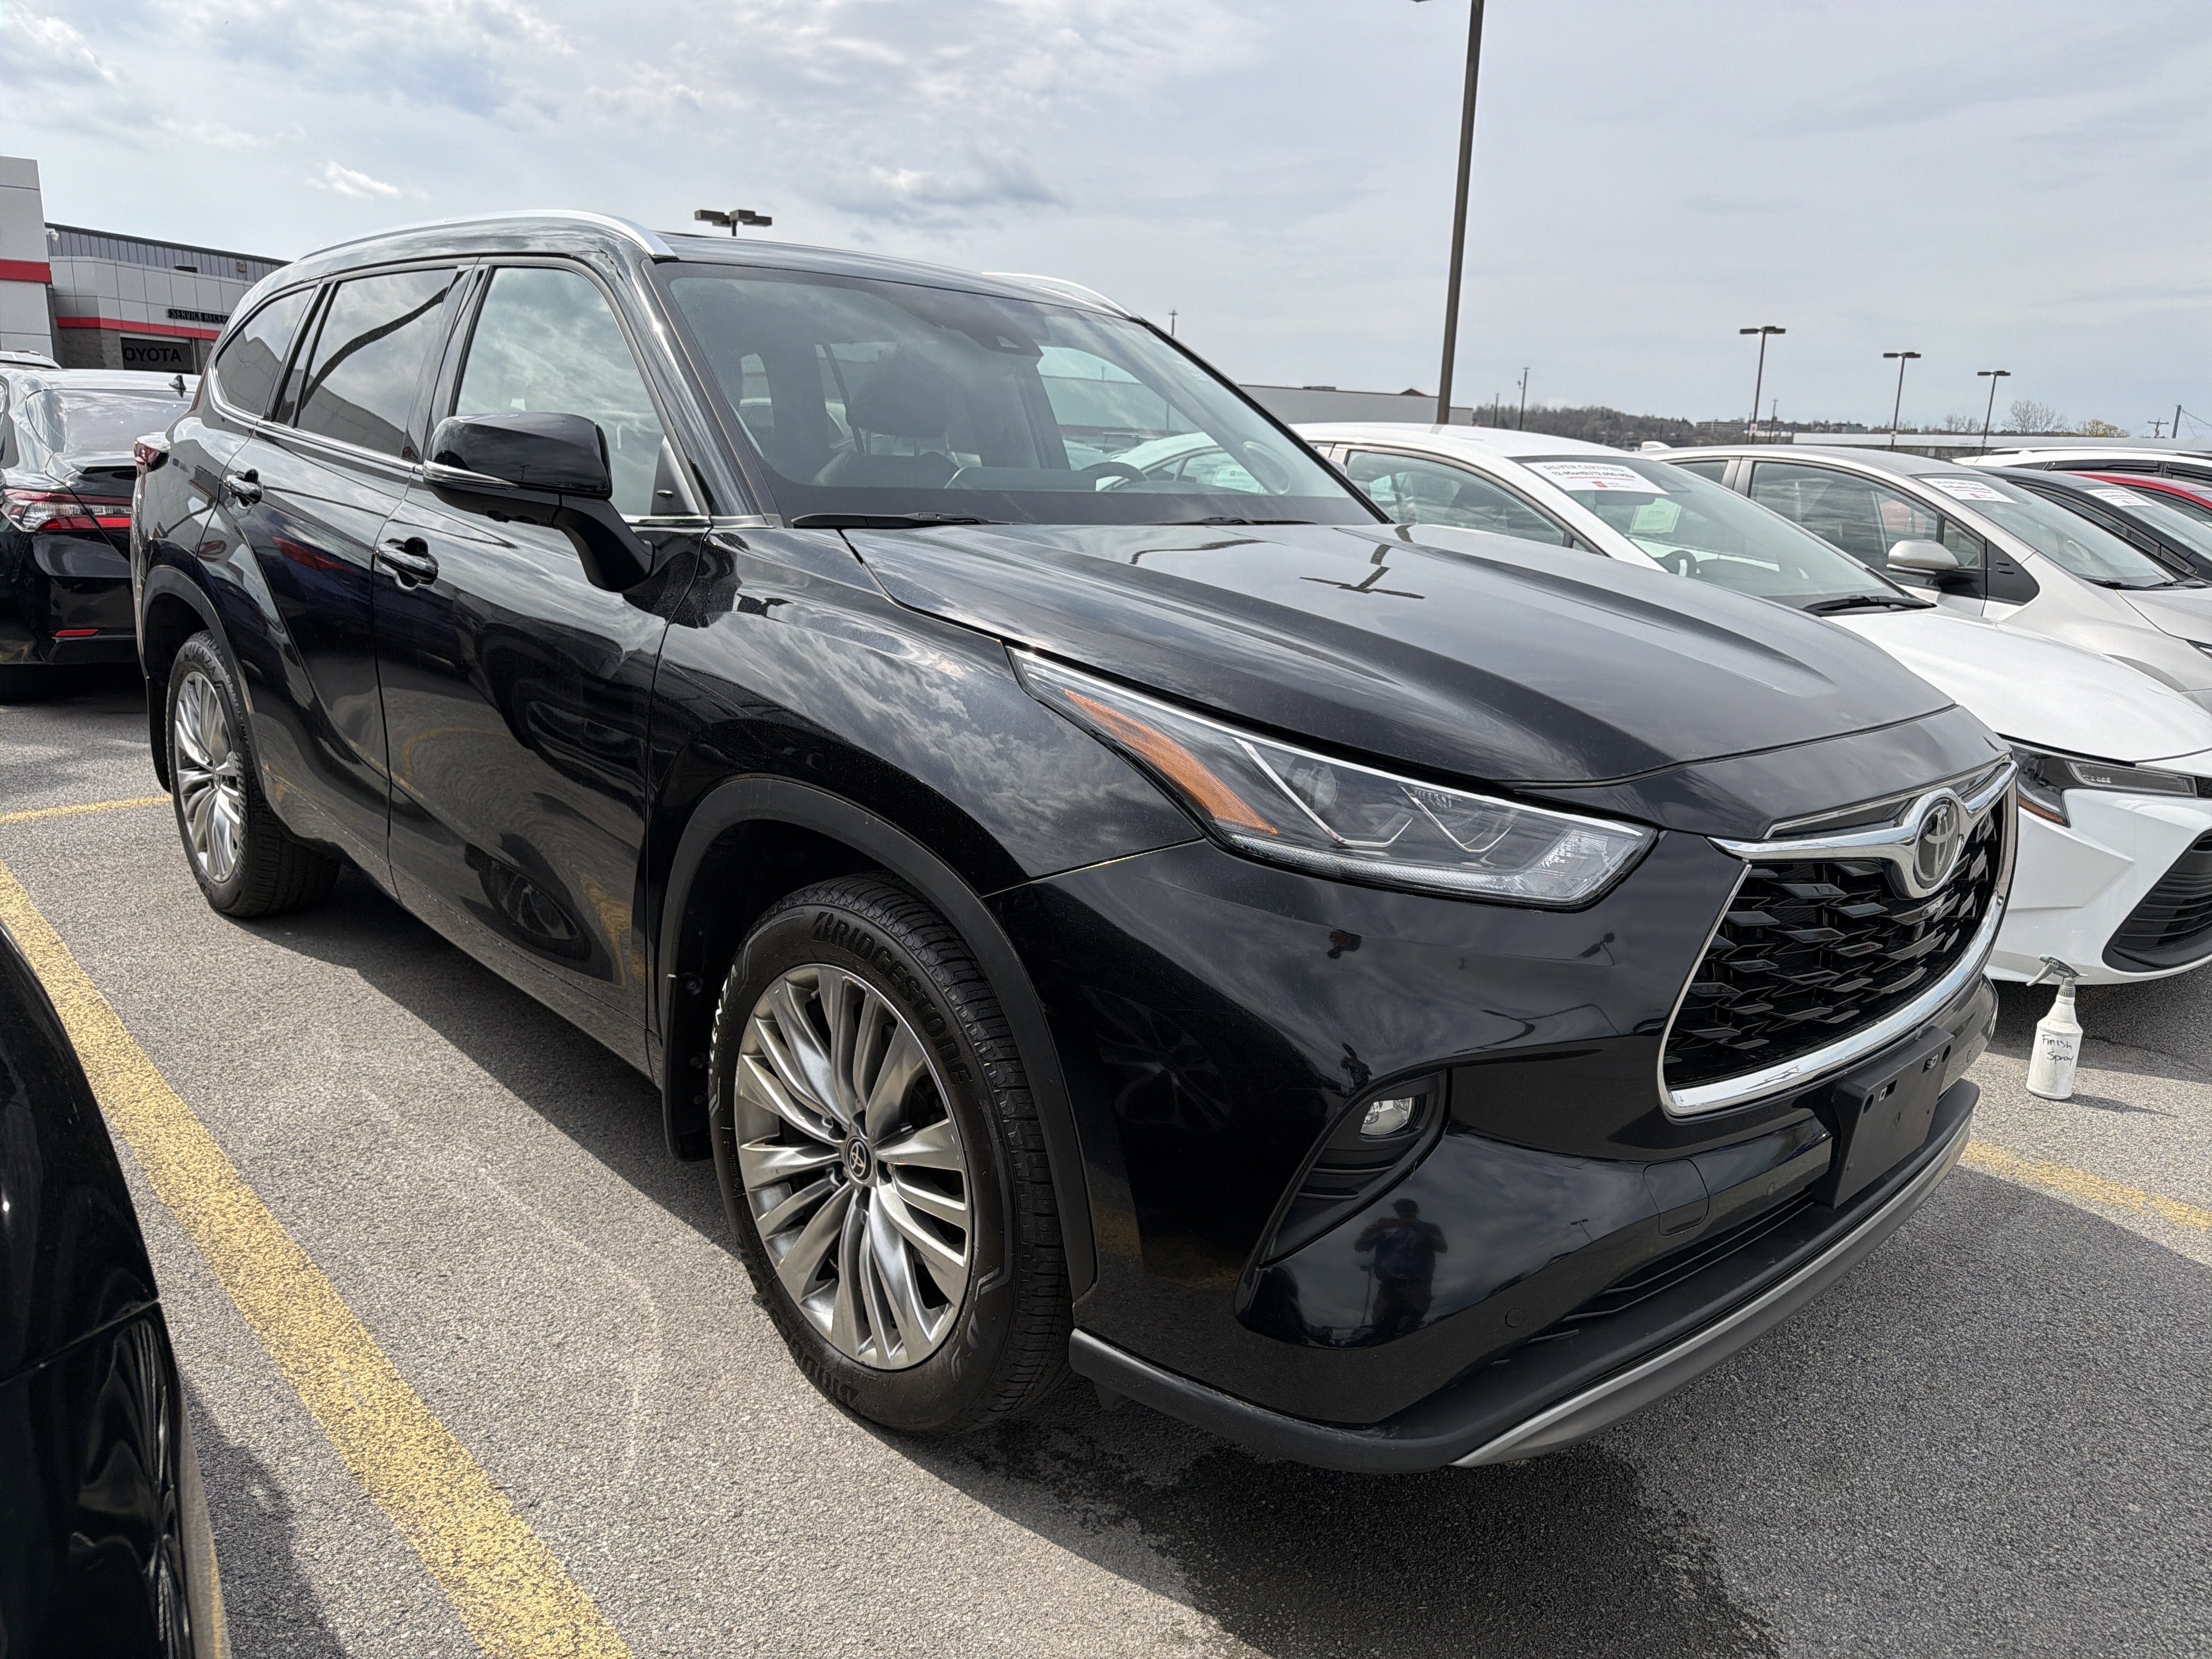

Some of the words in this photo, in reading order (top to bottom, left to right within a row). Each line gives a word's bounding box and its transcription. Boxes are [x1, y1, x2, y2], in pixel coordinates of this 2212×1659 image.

[811, 912, 974, 1087] BRIDGESTONE
[2041, 1035, 2072, 1050] Finish
[2047, 1051, 2074, 1066] Spray
